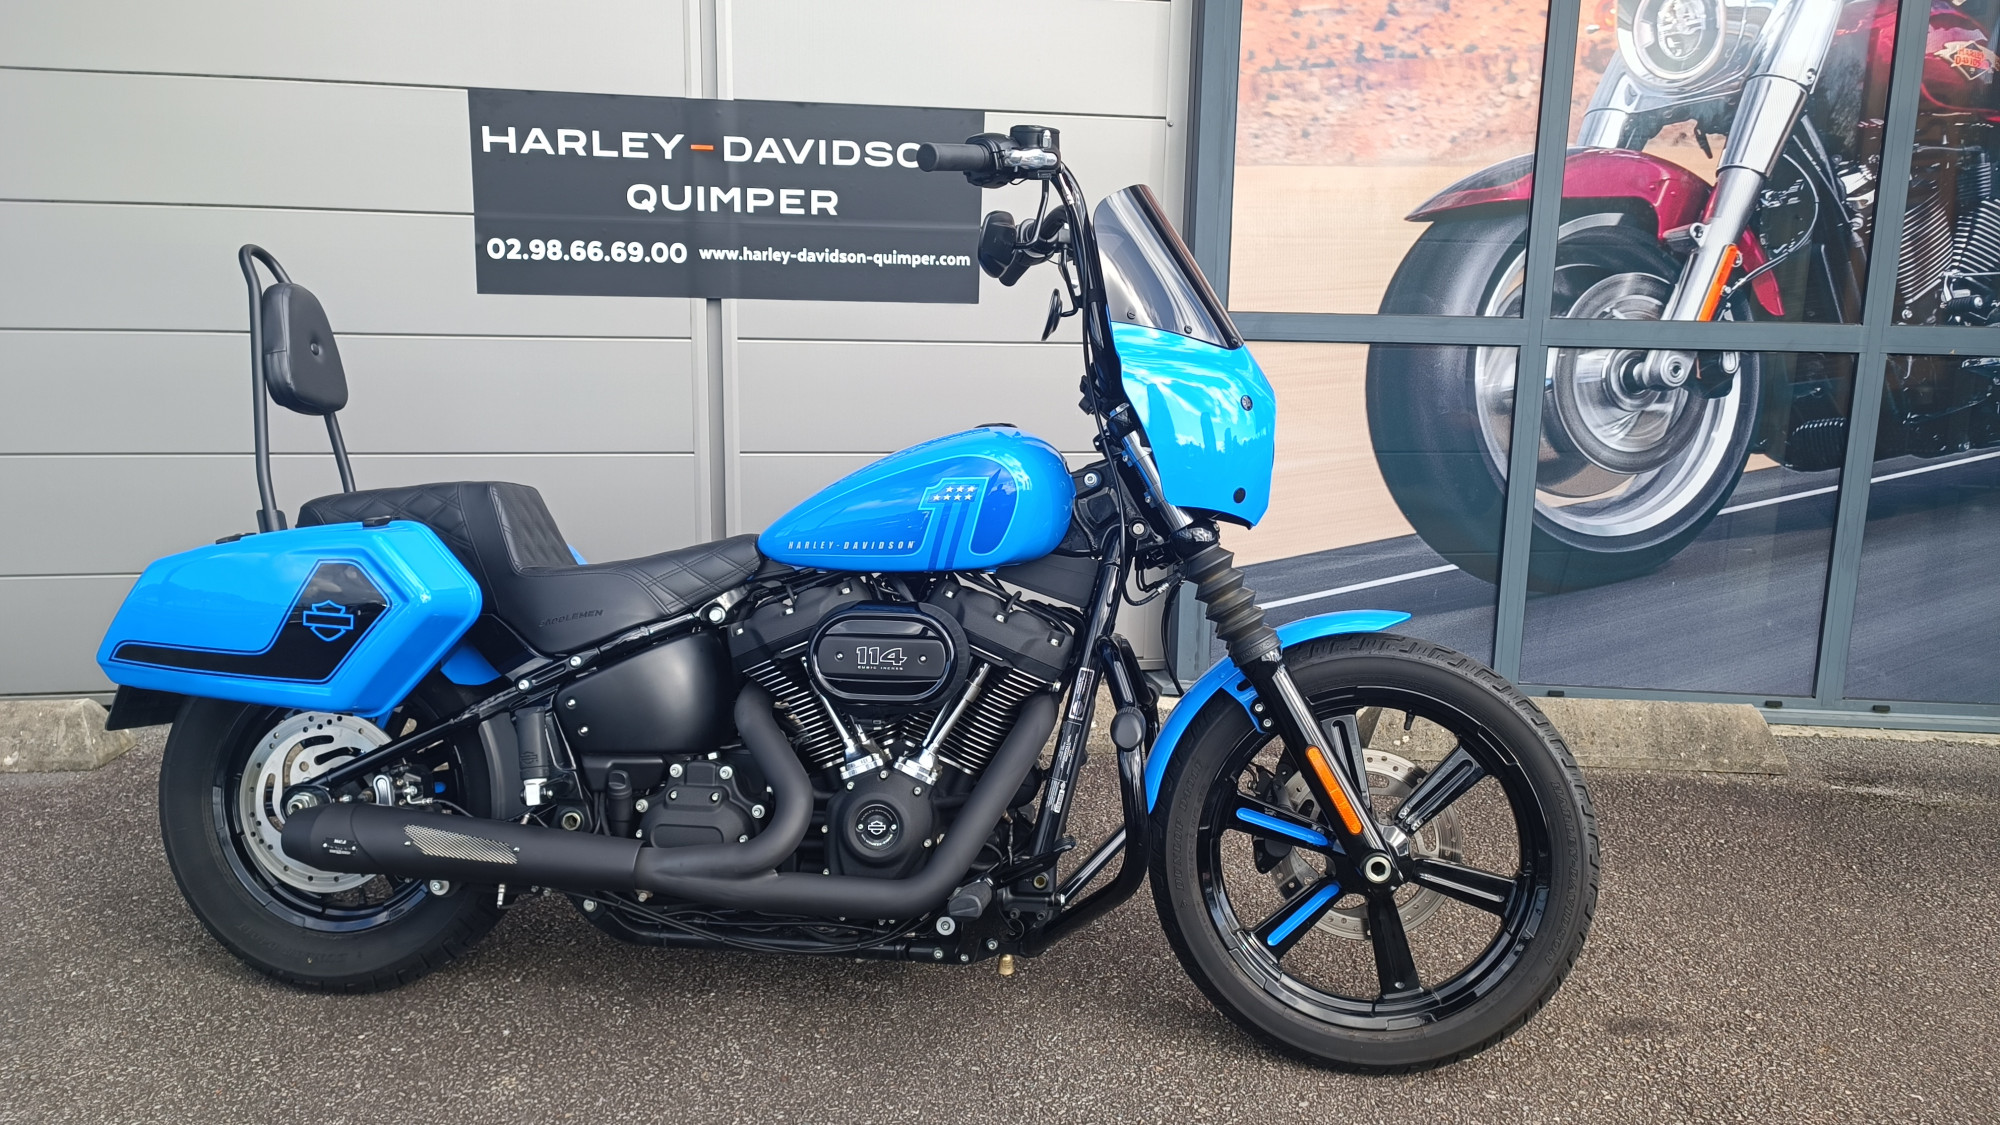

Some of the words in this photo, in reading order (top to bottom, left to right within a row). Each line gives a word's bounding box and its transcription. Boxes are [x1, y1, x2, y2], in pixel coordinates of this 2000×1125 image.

[481, 125, 920, 168] HARLEY-DAVIDSO
[626, 183, 838, 216] QUIMPER
[486, 237, 688, 264] 02.98.66.69.00
[699, 246, 971, 267] www.harley-davidson-quimper.com
[788, 540, 915, 550] HARLEY-DAVIDSON
[856, 646, 907, 666] 114
